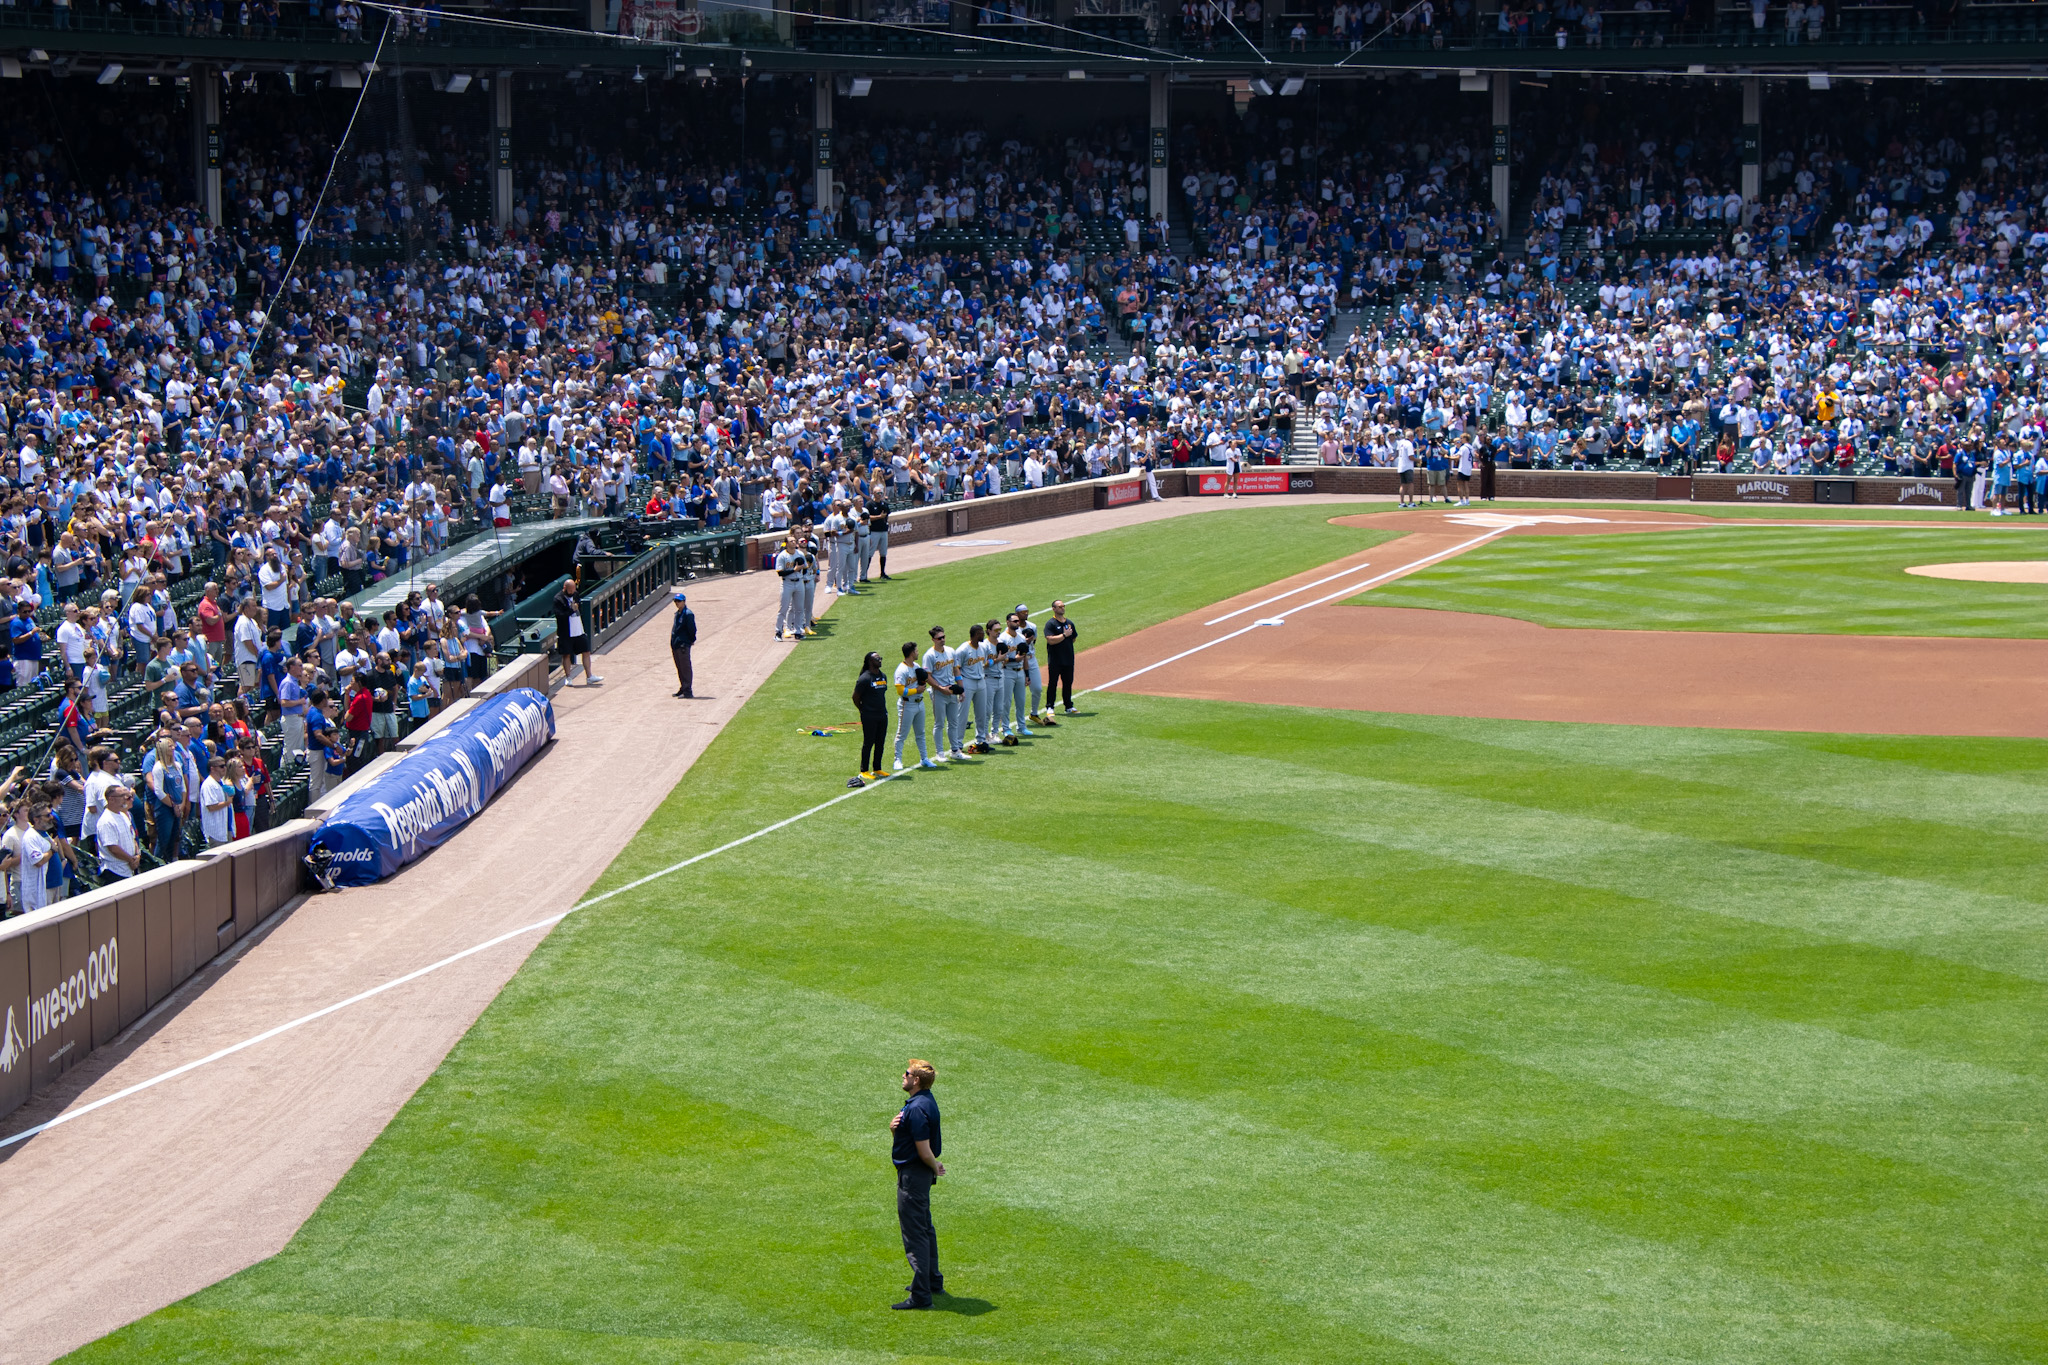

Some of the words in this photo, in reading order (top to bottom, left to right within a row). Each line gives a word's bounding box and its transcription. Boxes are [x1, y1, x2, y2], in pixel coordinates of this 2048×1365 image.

[819, 138, 830, 147] 217
[1153, 137, 1164, 146] 216
[1495, 135, 1506, 144] 215
[1745, 140, 1756, 149] 214
[500, 150, 510, 159] 217
[819, 150, 830, 159] 216
[1153, 149, 1164, 158] 215
[1495, 147, 1506, 156] 214
[1290, 479, 1313, 488] eero
[1736, 481, 1790, 496] MARQUEE
[1897, 486, 1916, 502] JIM
[1916, 483, 1942, 502] BEAM
[474, 712, 525, 780] Reynolds
[505, 701, 543, 746] Wrap
[370, 781, 443, 856] Reynolds
[424, 767, 470, 818] Wrap
[332, 847, 374, 863] nolds
[27, 968, 87, 1049] Invesco
[88, 936, 119, 1001] QQQ
